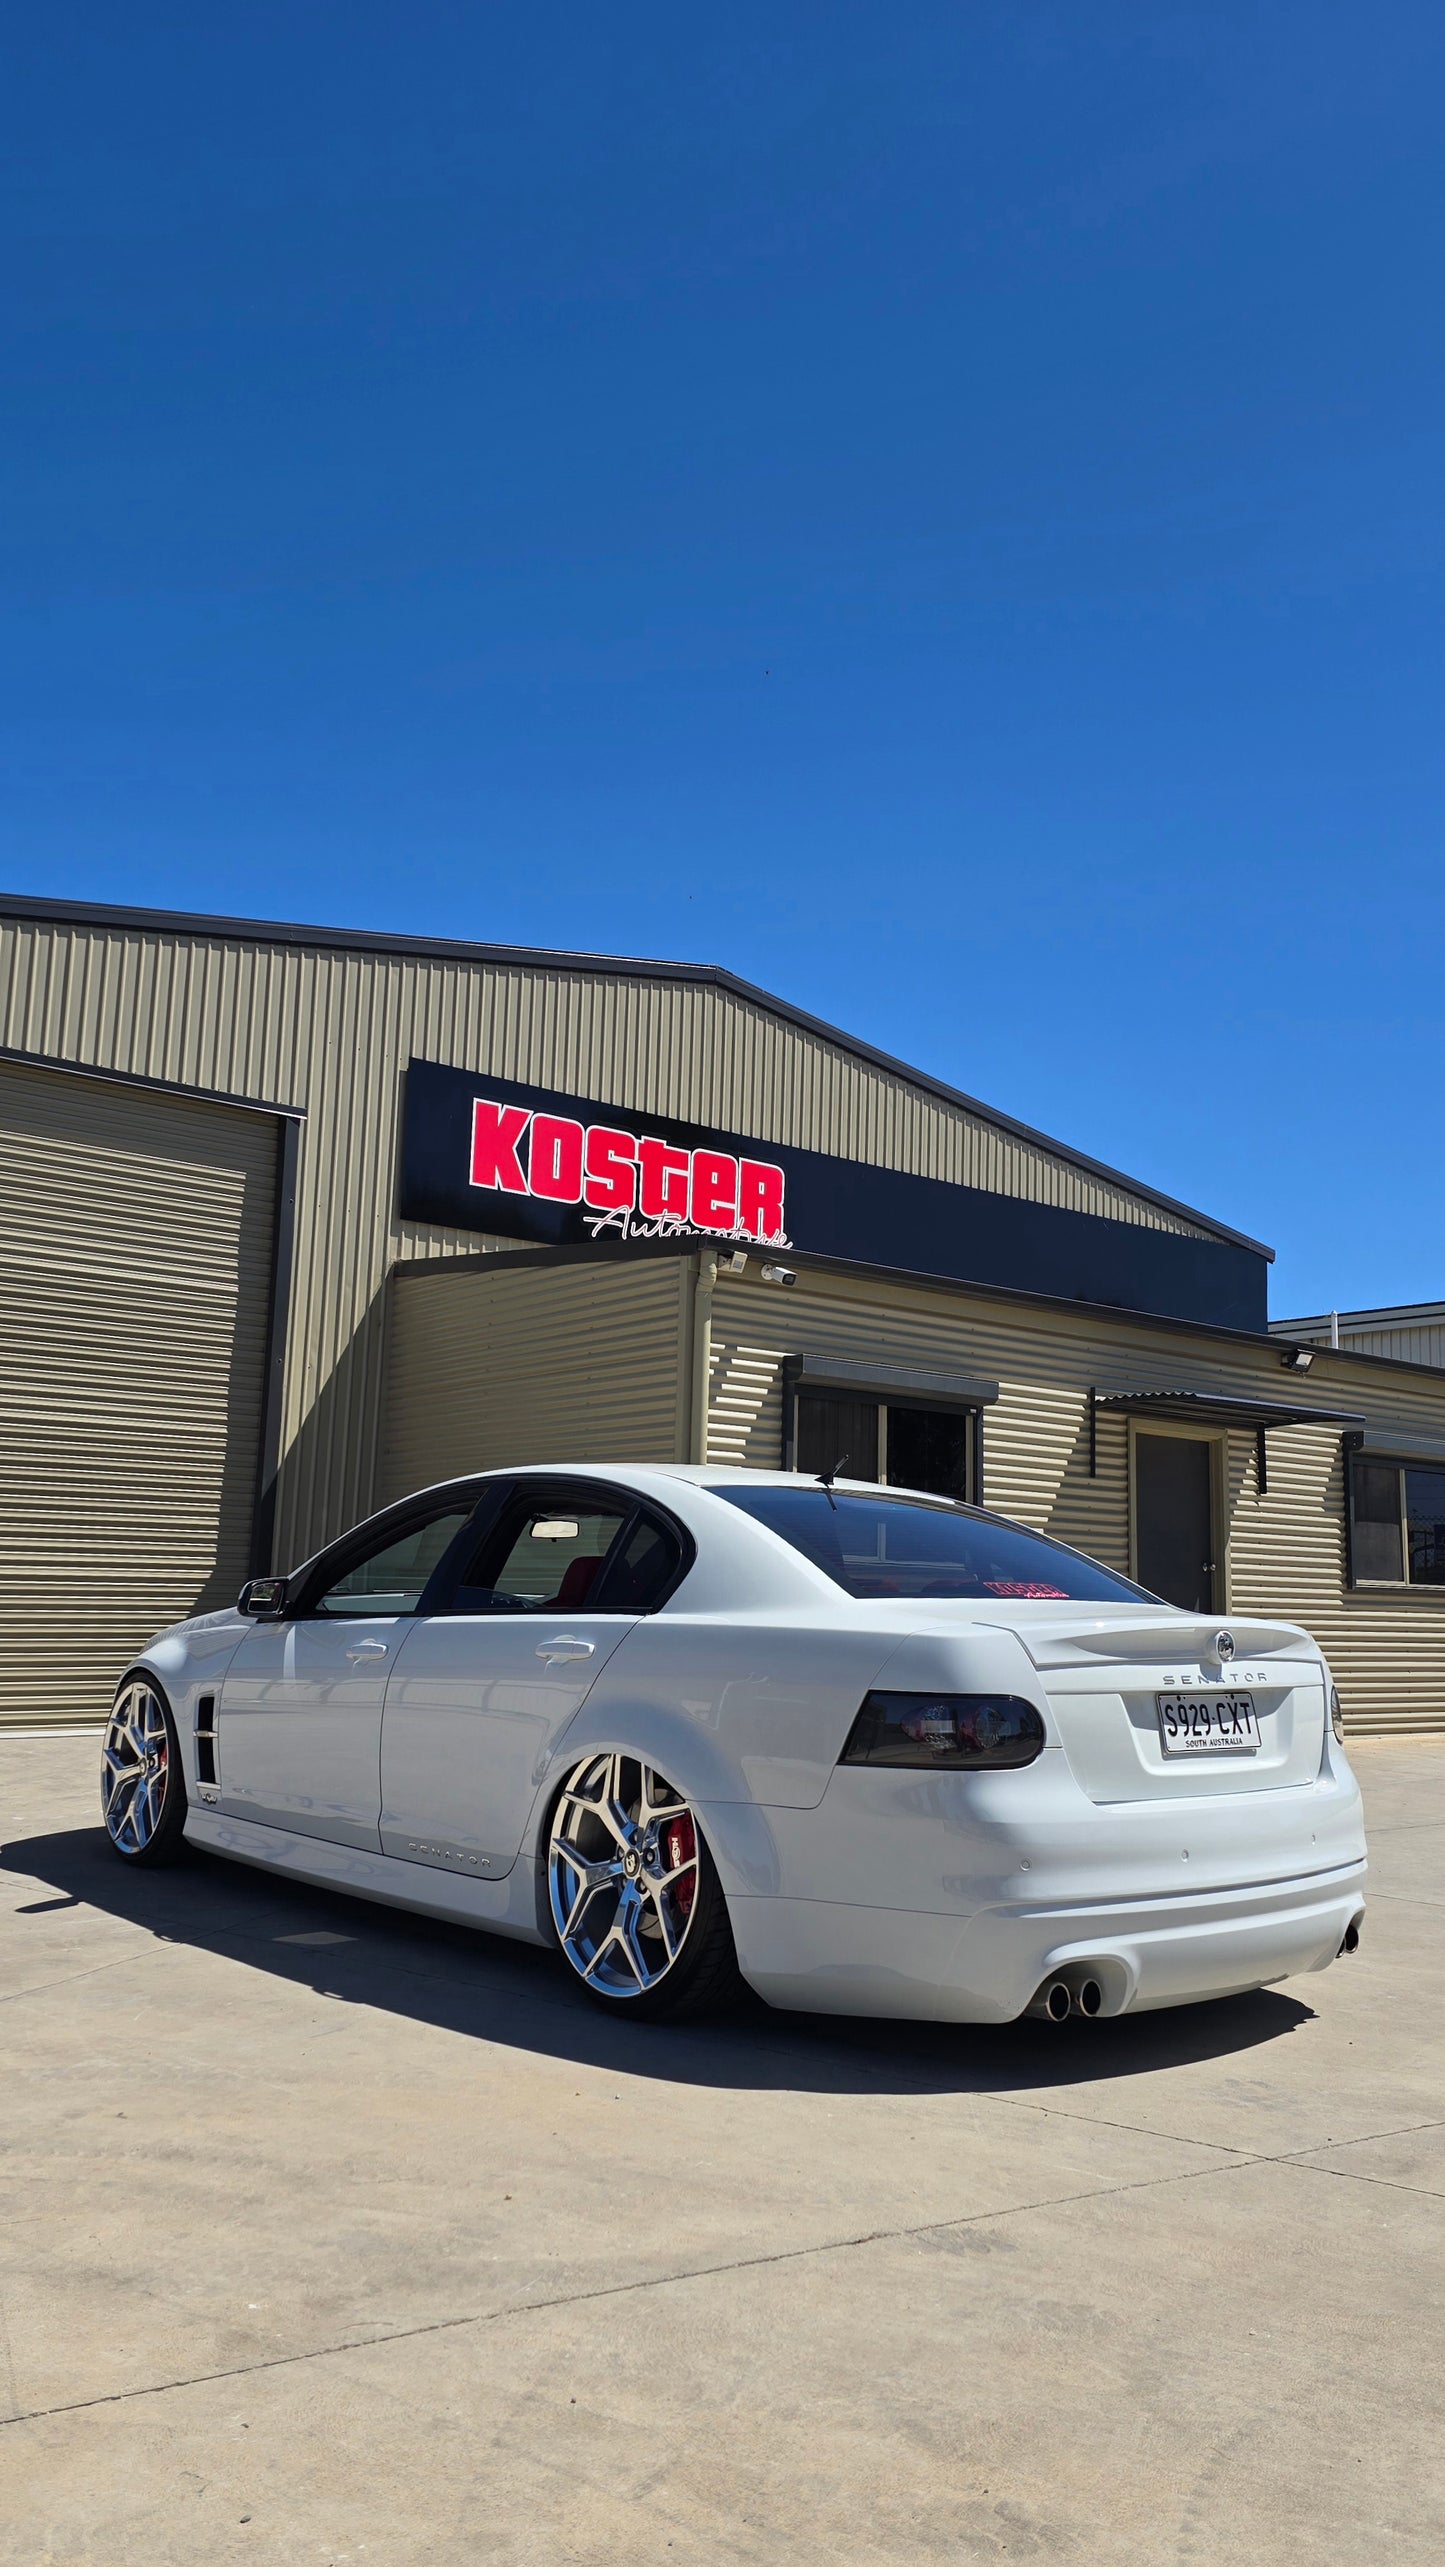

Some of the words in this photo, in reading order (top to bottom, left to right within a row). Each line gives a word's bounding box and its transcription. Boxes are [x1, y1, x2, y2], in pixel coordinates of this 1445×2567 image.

[1163, 1673, 1267, 1685] SENATOR
[1185, 1739, 1207, 1748] SOUTH
[1209, 1738, 1243, 1747] AUSTRALIA
[408, 1842, 492, 1868] SENATOR
